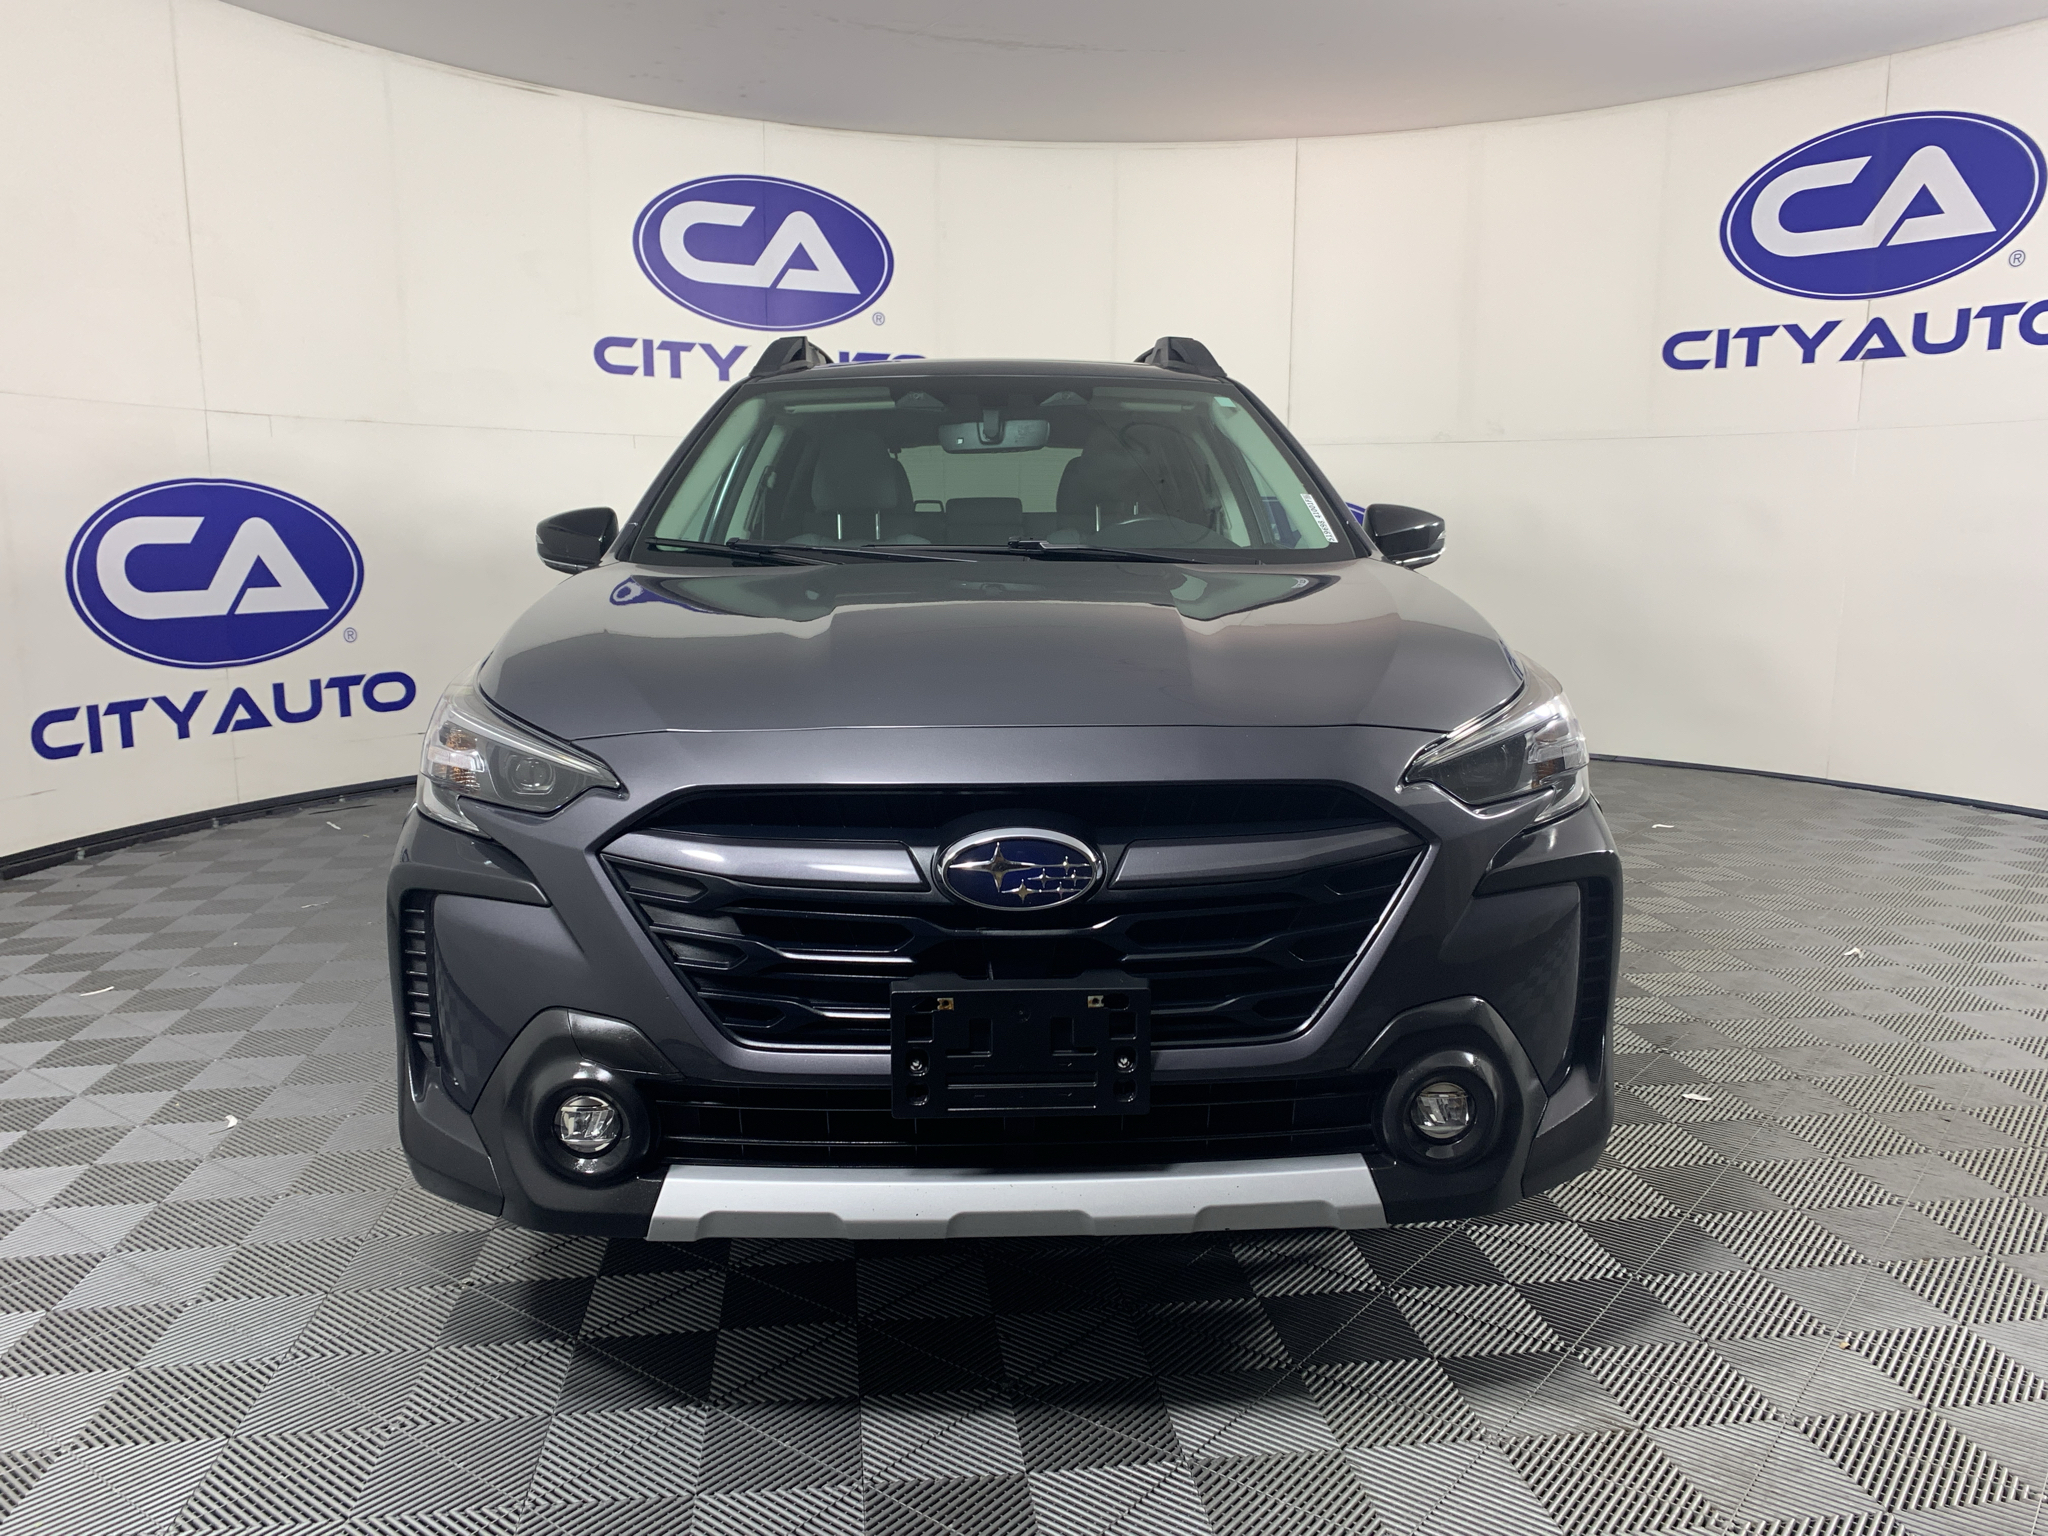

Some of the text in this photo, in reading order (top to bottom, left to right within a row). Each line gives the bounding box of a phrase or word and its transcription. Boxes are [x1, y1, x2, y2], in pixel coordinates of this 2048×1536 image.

[659, 200, 861, 294] CA
[1751, 145, 1997, 258] CA
[593, 336, 750, 382] CITY
[1662, 319, 1843, 370] CITY
[96, 516, 329, 620] CA
[31, 671, 416, 760] CITY AUTO
